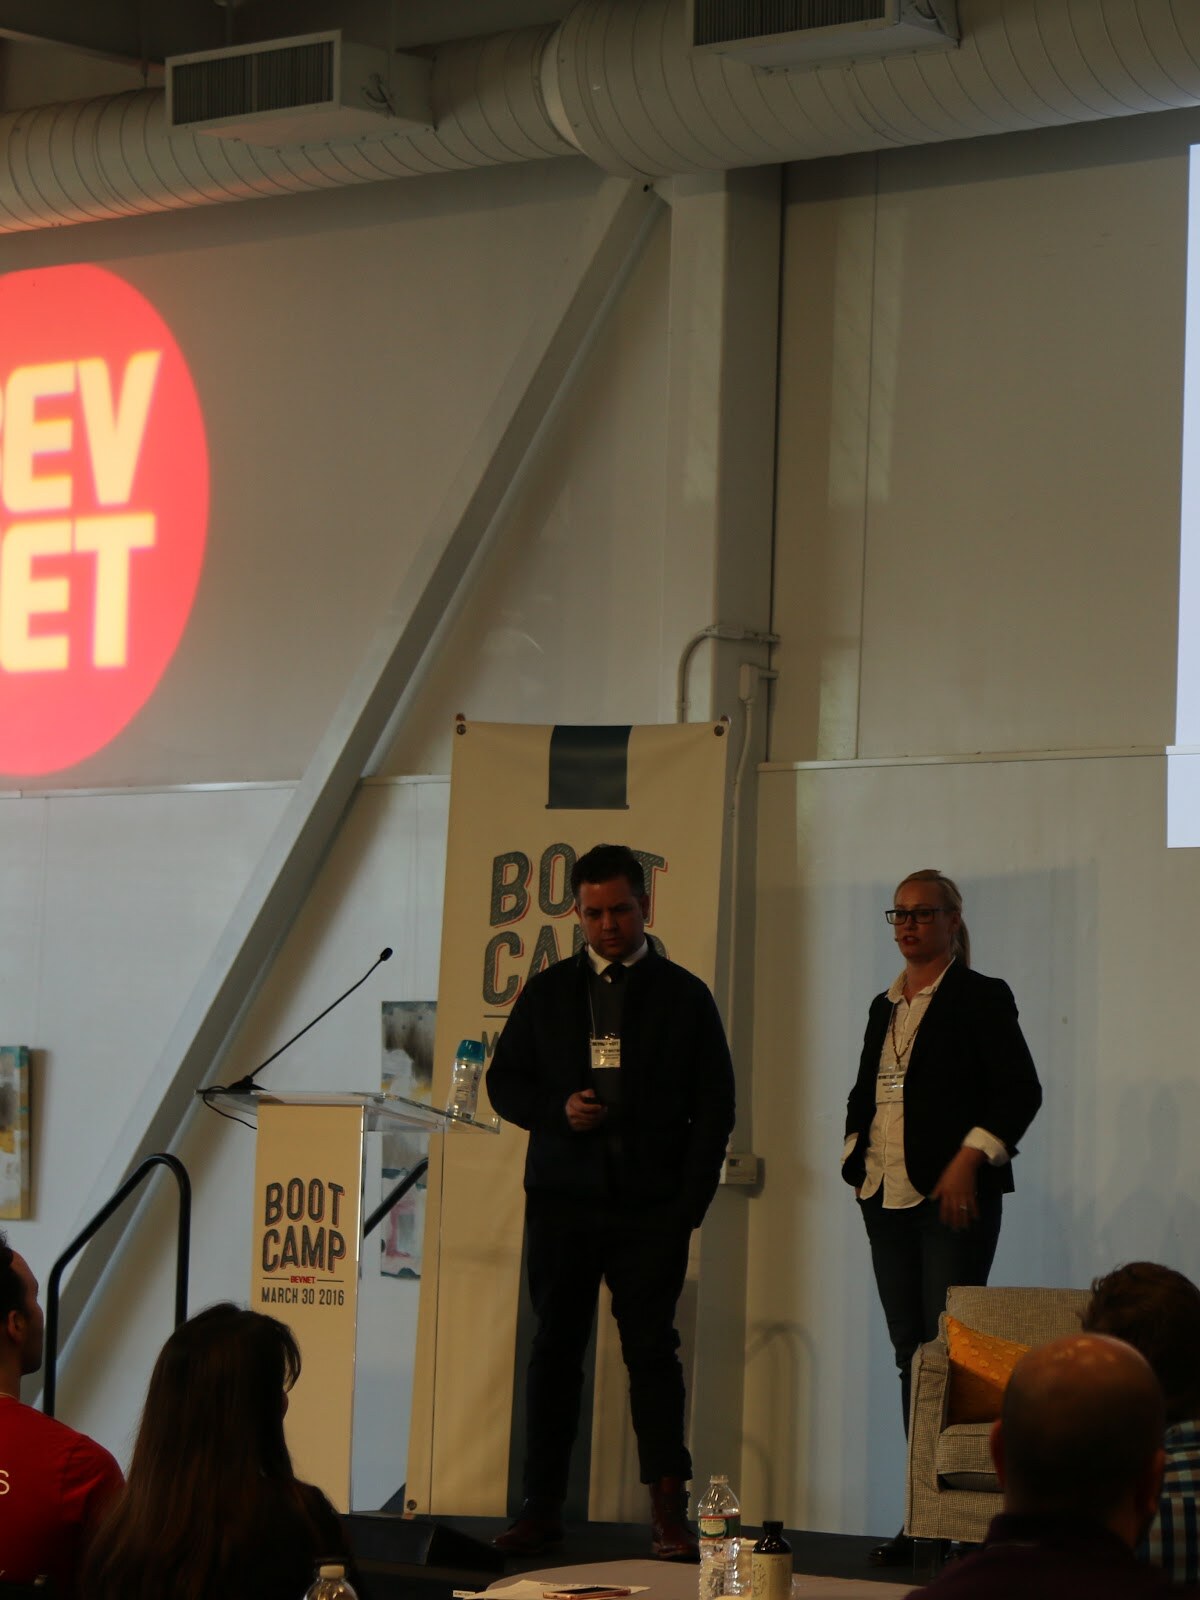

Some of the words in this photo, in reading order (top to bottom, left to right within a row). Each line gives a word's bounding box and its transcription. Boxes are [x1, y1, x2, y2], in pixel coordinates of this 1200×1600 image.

[0, 351, 161, 513] EV
[490, 843, 668, 928] BOT
[265, 1177, 346, 1228] BOOT
[262, 1225, 346, 1273] CAMP
[261, 1286, 298, 1304] MARCH
[302, 1288, 315, 1305] 30
[319, 1289, 345, 1306] 2016
[290, 1275, 316, 1284] BEVNET
